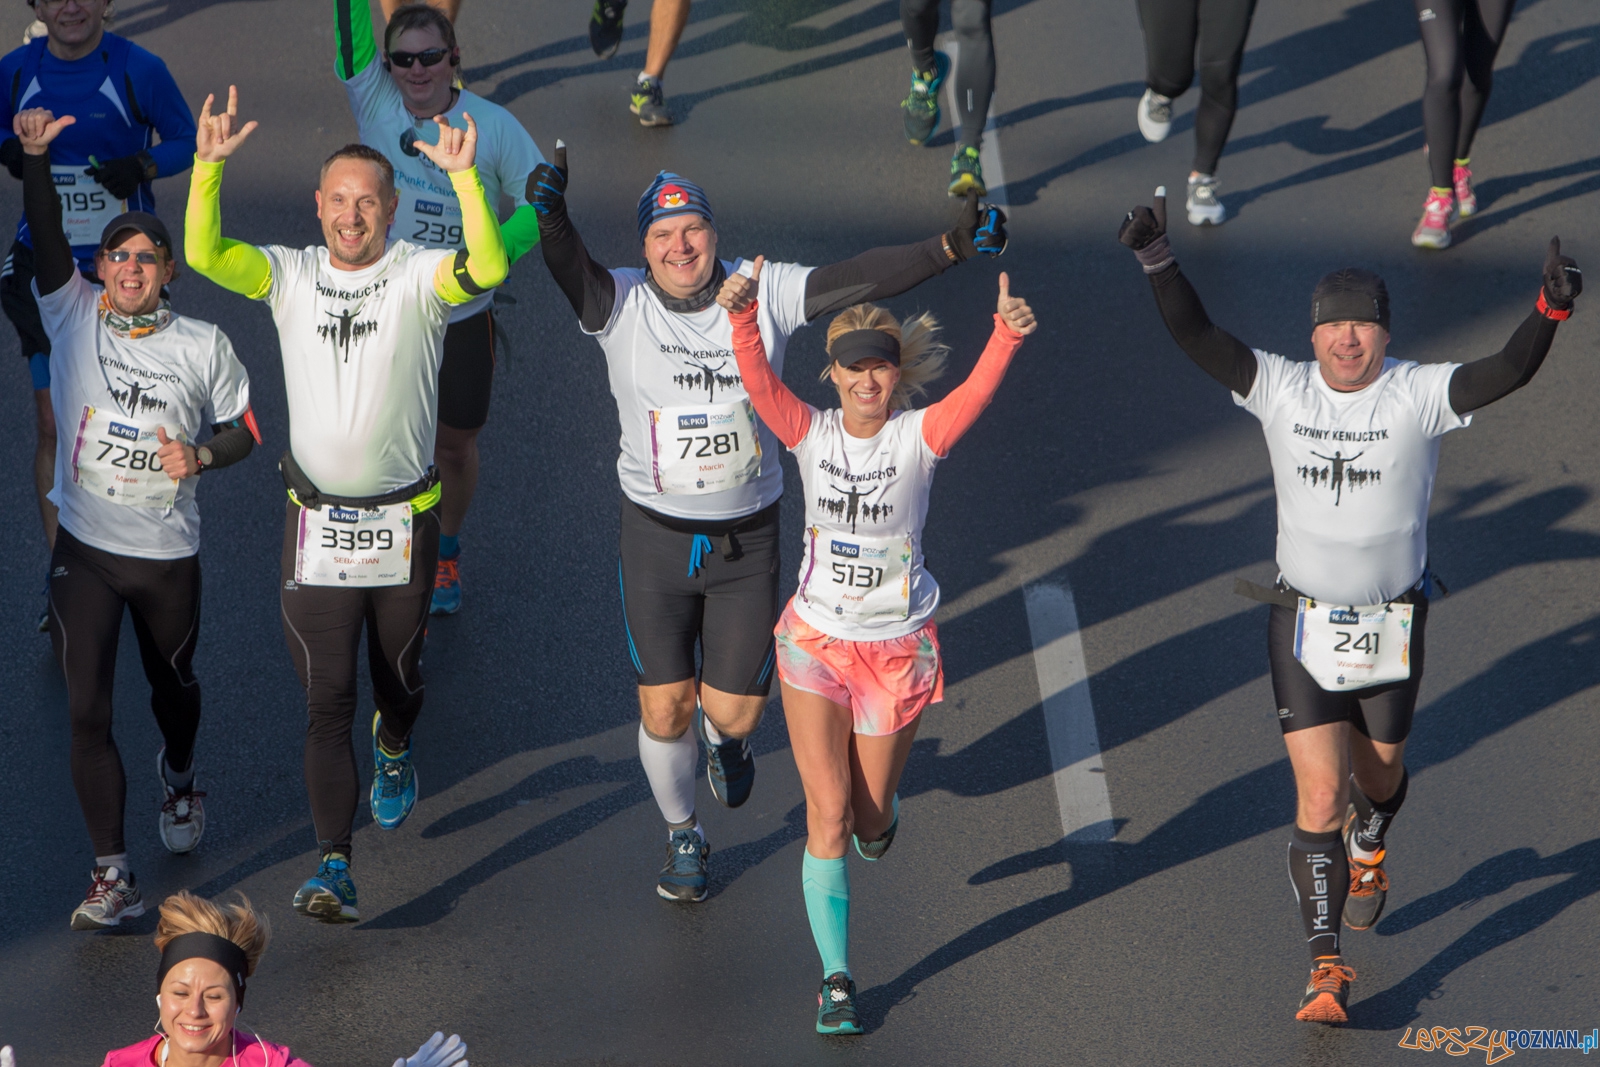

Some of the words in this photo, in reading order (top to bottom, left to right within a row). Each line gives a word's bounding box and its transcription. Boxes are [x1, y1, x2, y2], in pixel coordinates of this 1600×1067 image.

[60, 175, 74, 183] PKO
[428, 182, 457, 198] Active
[58, 191, 106, 212] 195
[417, 201, 426, 211] 16.
[427, 203, 441, 213] PKO
[98, 355, 129, 373] SŁYNNI
[129, 365, 181, 384] KENIJCZYCY
[680, 418, 691, 427] 16.
[691, 417, 706, 427] PKO
[110, 424, 120, 435] 16.
[121, 426, 137, 439] PKO
[1293, 423, 1330, 441] SŁYNNY
[1332, 428, 1389, 442] KENIJCZYK
[677, 431, 739, 460] 7281
[96, 439, 163, 472] 7280
[699, 462, 725, 472] Marcin
[115, 474, 139, 485] Marek
[330, 511, 341, 519] 16.
[341, 512, 357, 521] PKO
[321, 526, 393, 551] 3399
[832, 543, 842, 552] 16.
[842, 547, 857, 555] PKO
[832, 561, 884, 588] 5131
[1333, 631, 1380, 655] 241
